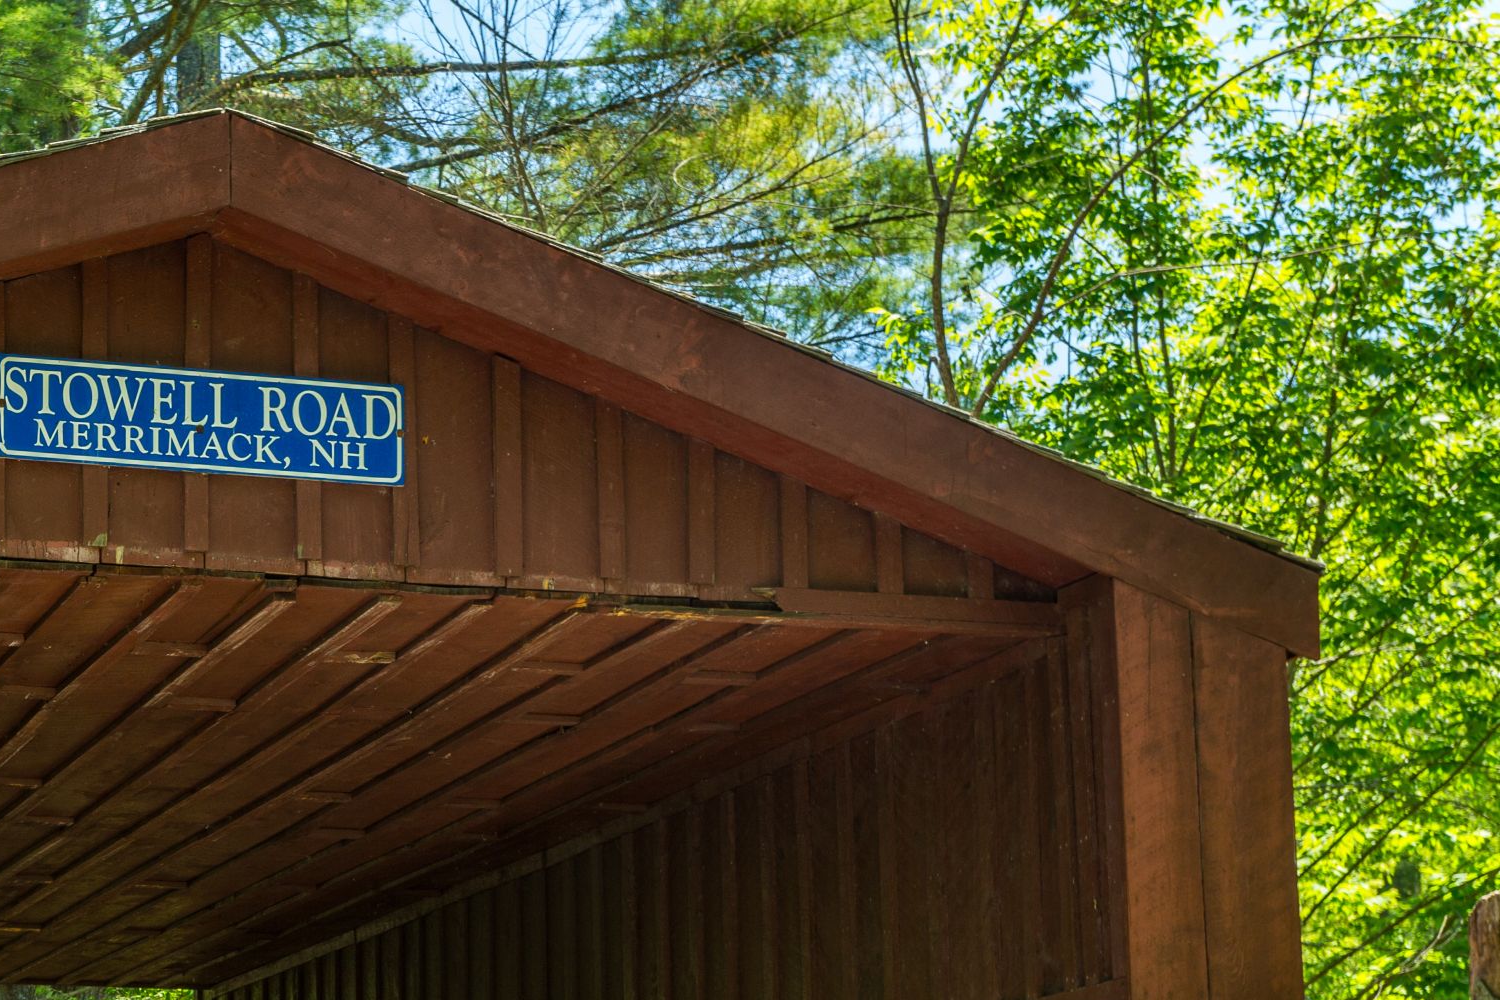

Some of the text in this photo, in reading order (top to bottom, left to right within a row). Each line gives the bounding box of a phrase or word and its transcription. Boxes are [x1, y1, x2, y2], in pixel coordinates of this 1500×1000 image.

[5, 366, 397, 441] STOWELL ROAD
[33, 418, 369, 471] MERRIMACK, NH
